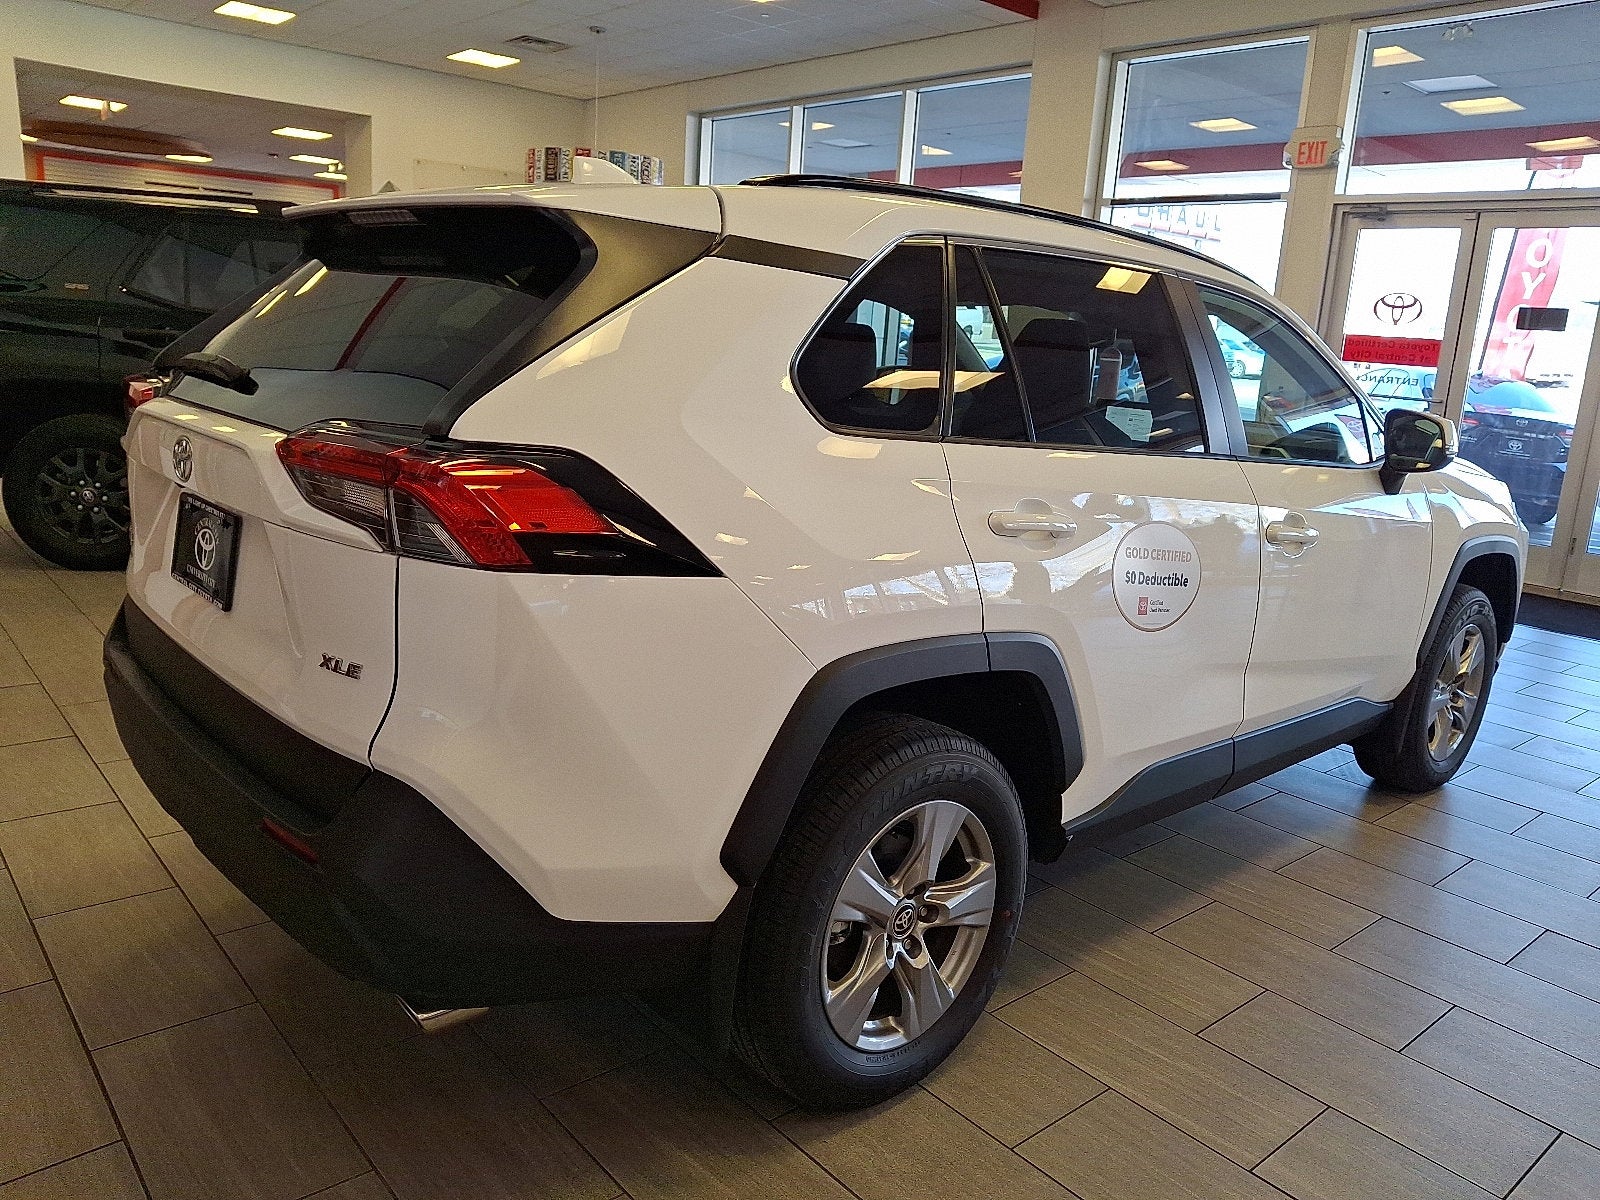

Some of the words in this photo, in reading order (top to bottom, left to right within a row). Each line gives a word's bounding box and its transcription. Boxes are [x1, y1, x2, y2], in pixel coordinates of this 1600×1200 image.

[1297, 141, 1328, 164] EXIT
[1125, 546, 1149, 560] GOLD
[1150, 548, 1192, 562] CERTIFIED
[1125, 570, 1137, 585] $0
[1138, 571, 1189, 588] Deductible
[318, 652, 364, 681] XLE
